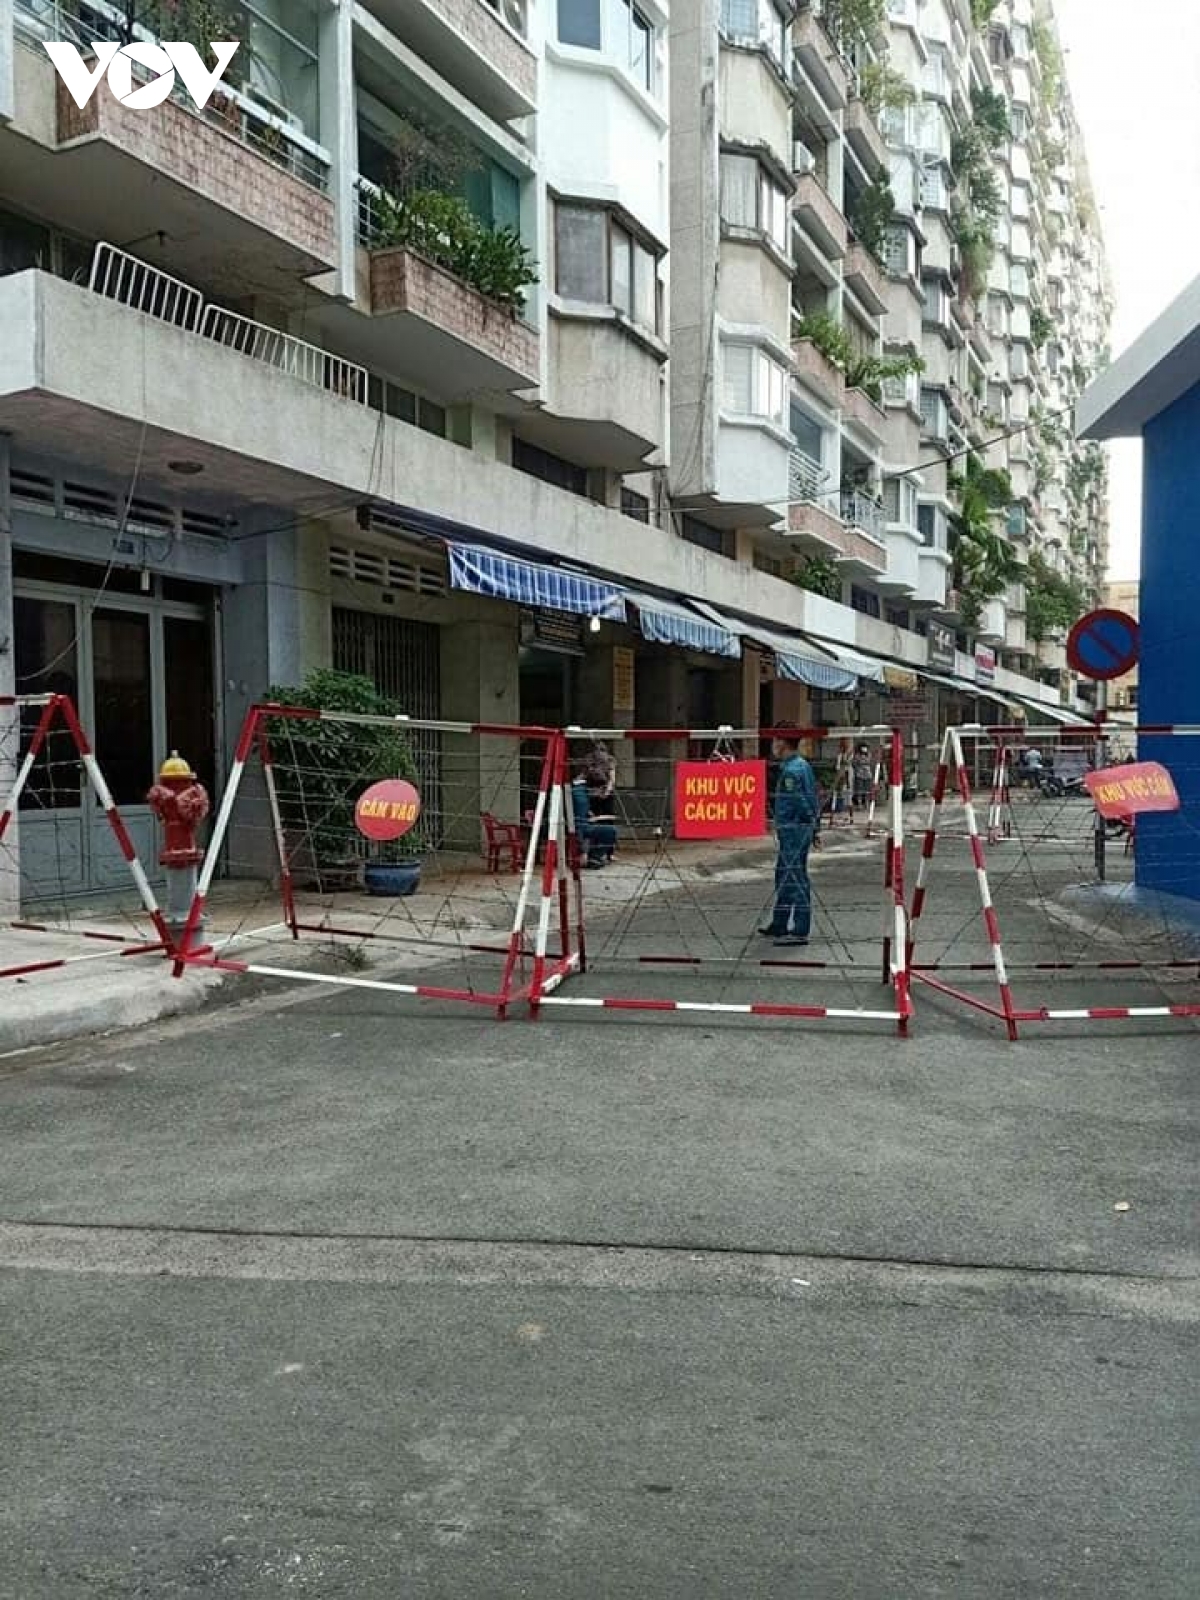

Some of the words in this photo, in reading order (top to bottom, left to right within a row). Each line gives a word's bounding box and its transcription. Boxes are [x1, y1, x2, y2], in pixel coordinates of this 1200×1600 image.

[685, 776, 719, 796] KHU
[723, 773, 756, 797] VỰC
[1095, 781, 1125, 803] KHU
[684, 799, 728, 821] CÁCH
[732, 801, 754, 821] LY
